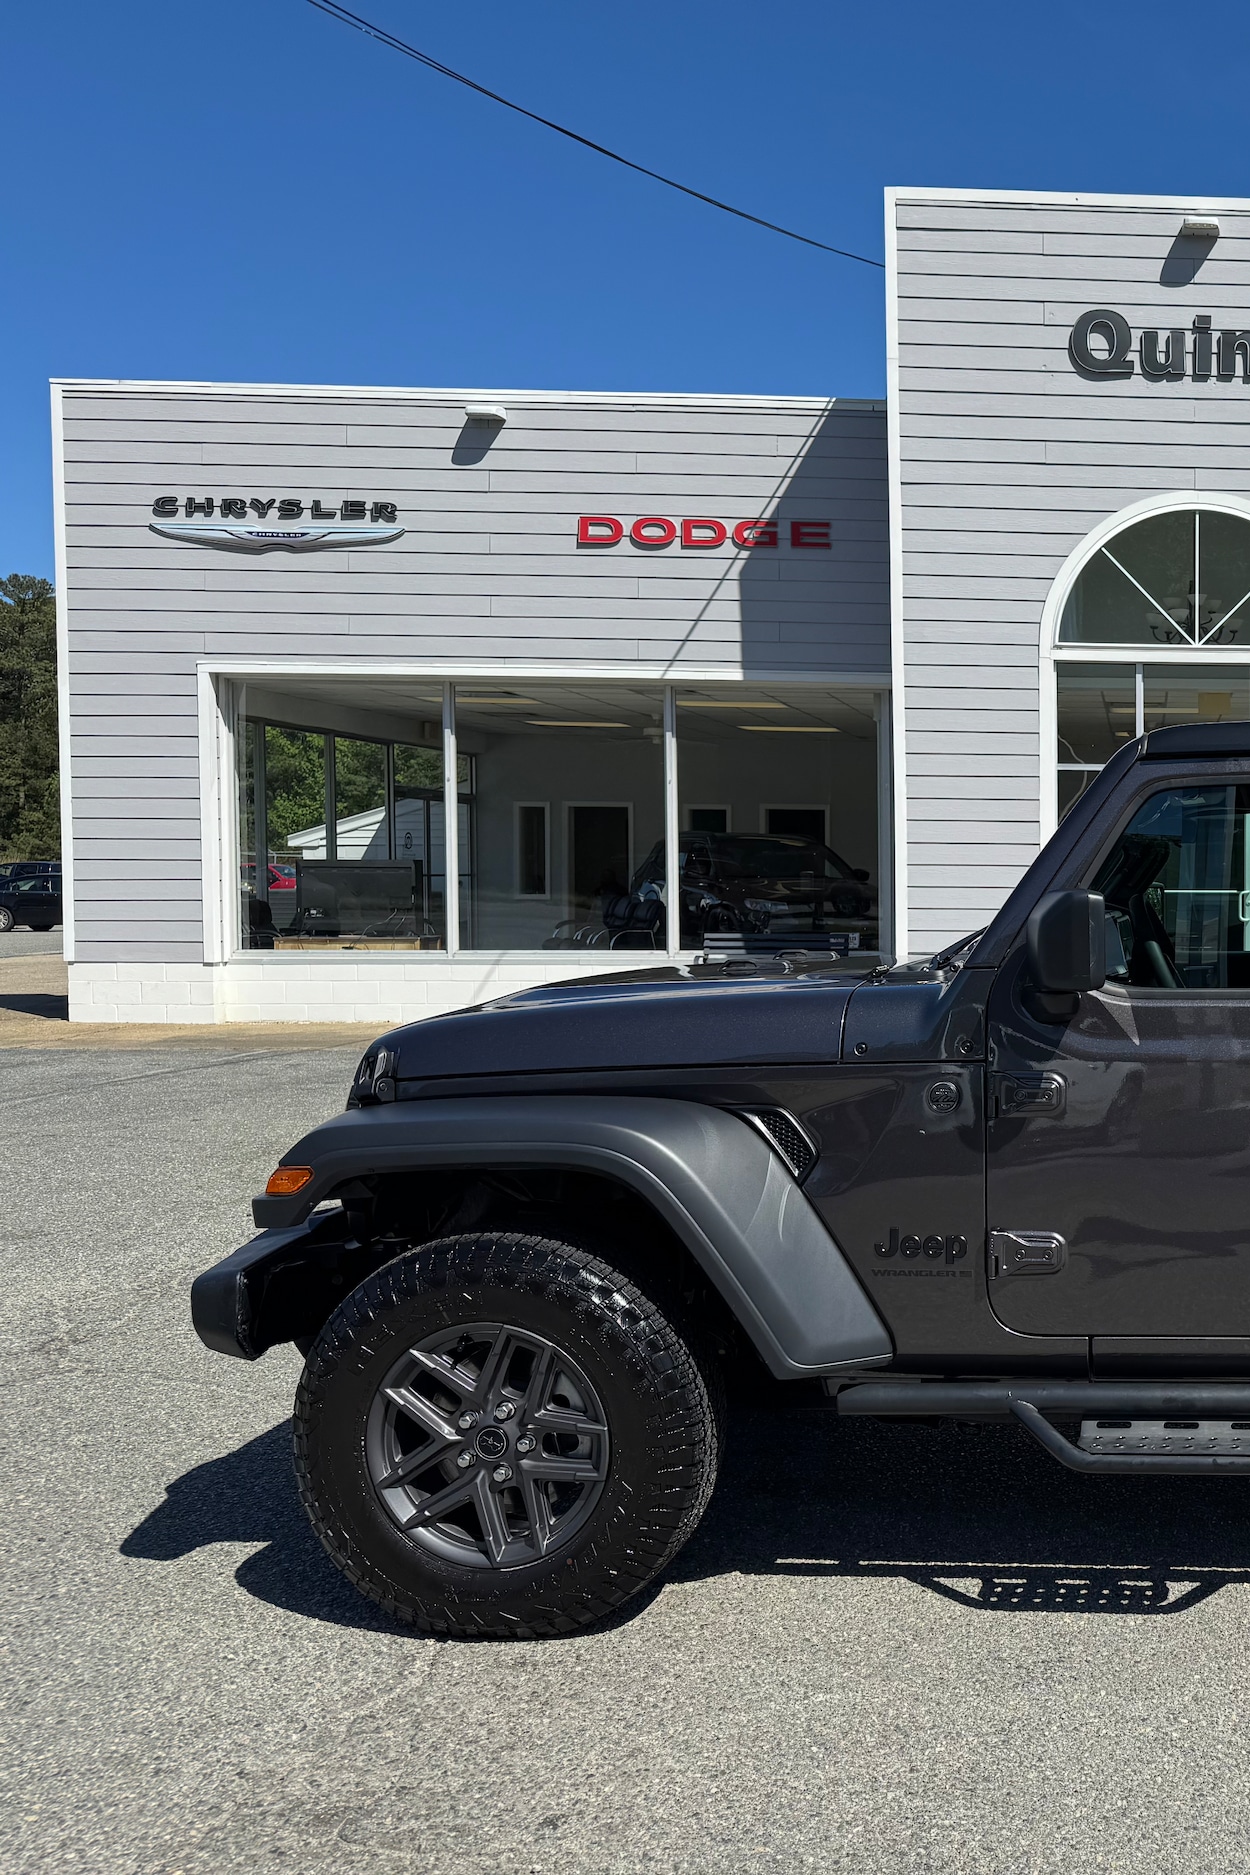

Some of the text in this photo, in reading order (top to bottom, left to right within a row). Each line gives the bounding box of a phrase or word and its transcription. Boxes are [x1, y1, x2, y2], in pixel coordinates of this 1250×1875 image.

[152, 496, 398, 522] CHRYSLER
[577, 516, 832, 549] DODGE
[874, 1227, 968, 1265] Jeep
[871, 1268, 957, 1278] WRANGLER
